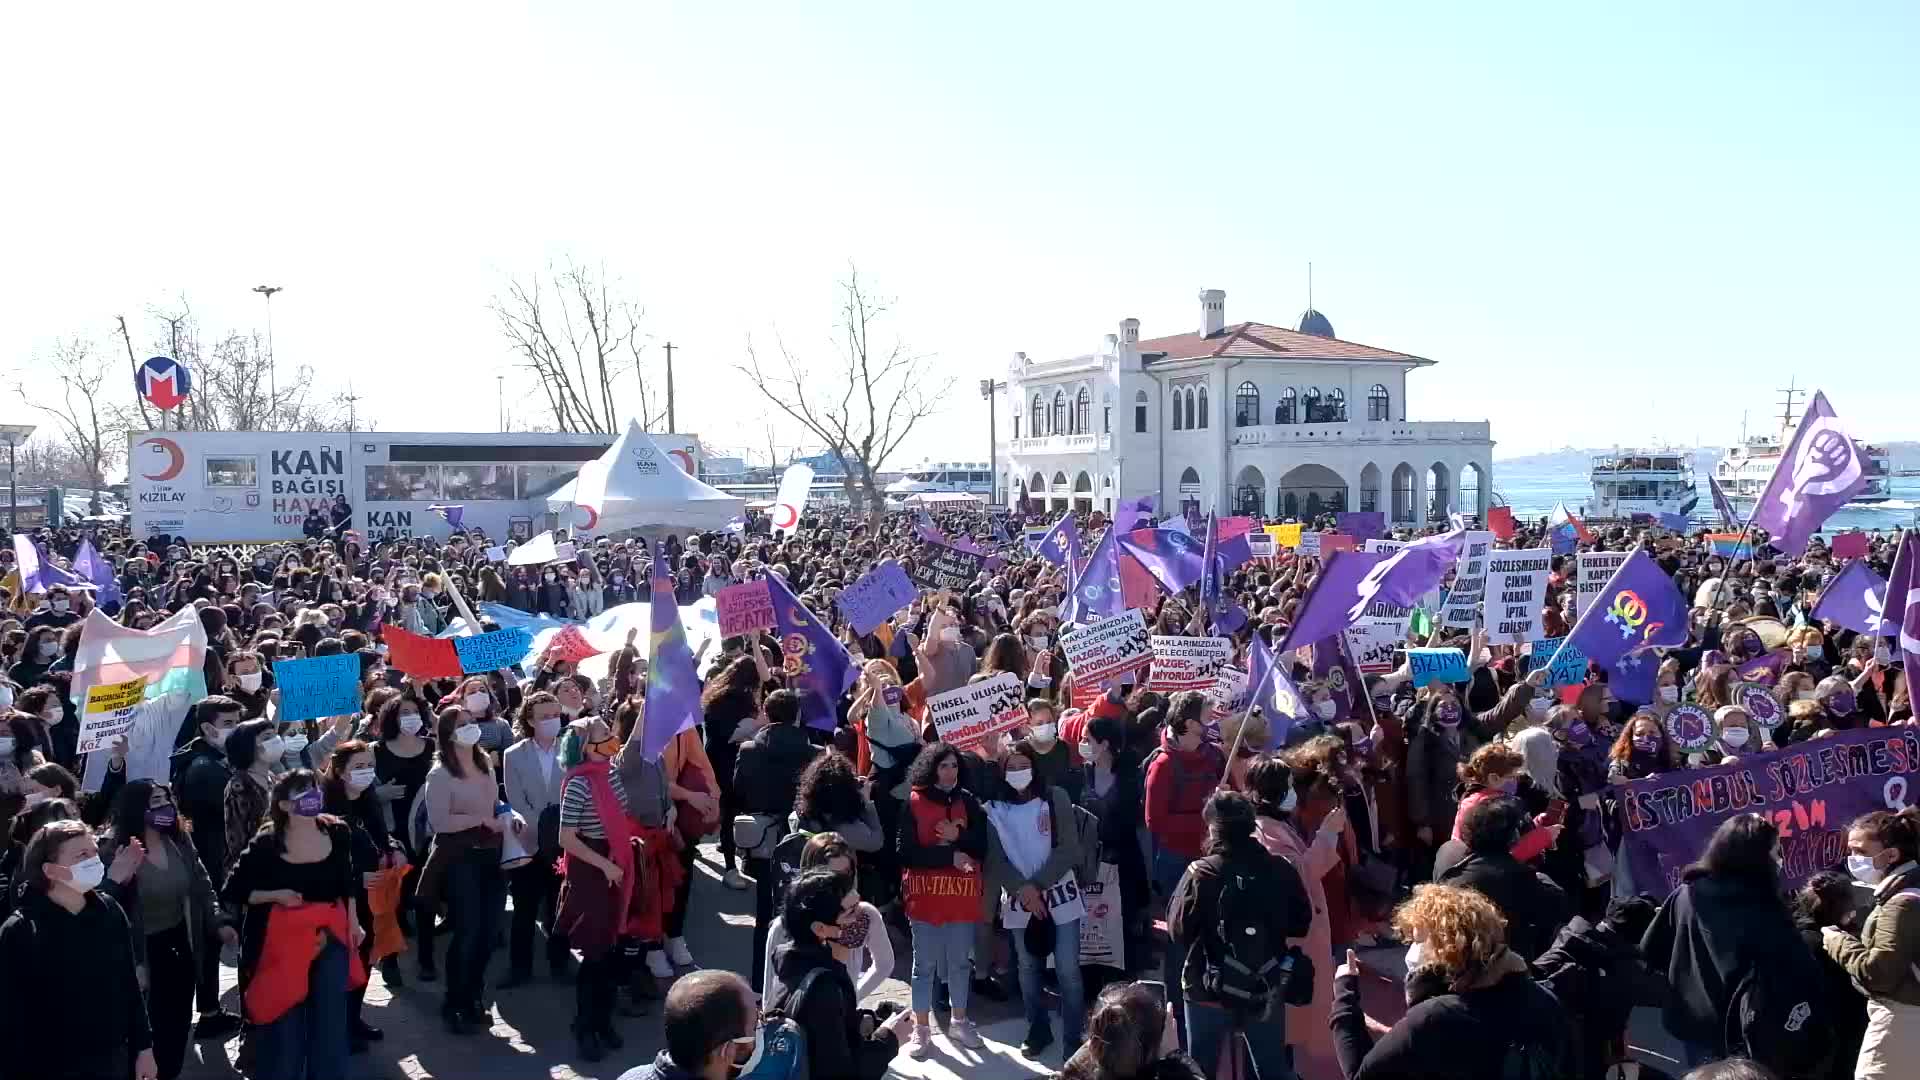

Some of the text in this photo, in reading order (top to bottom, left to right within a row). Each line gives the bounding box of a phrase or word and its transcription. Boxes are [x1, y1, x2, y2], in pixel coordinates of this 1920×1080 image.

[272, 450, 343, 475] KAN
[272, 476, 344, 497] BAĞIŞI
[139, 492, 186, 504] KIZILAY
[367, 511, 412, 527] KAN
[1504, 575, 1532, 589] ÇIKMA
[1501, 590, 1533, 603] KARARI
[1505, 604, 1528, 619] İPTAL
[1063, 614, 1133, 645] HAKLARIMIZDAN
[1153, 639, 1222, 648] HAKLARIMIZDAN
[971, 682, 1013, 701] ULUSAL,
[935, 707, 979, 726] SINIFSAL
[1624, 730, 1920, 832] İSTANBUL SÖZLEŞMESİ
